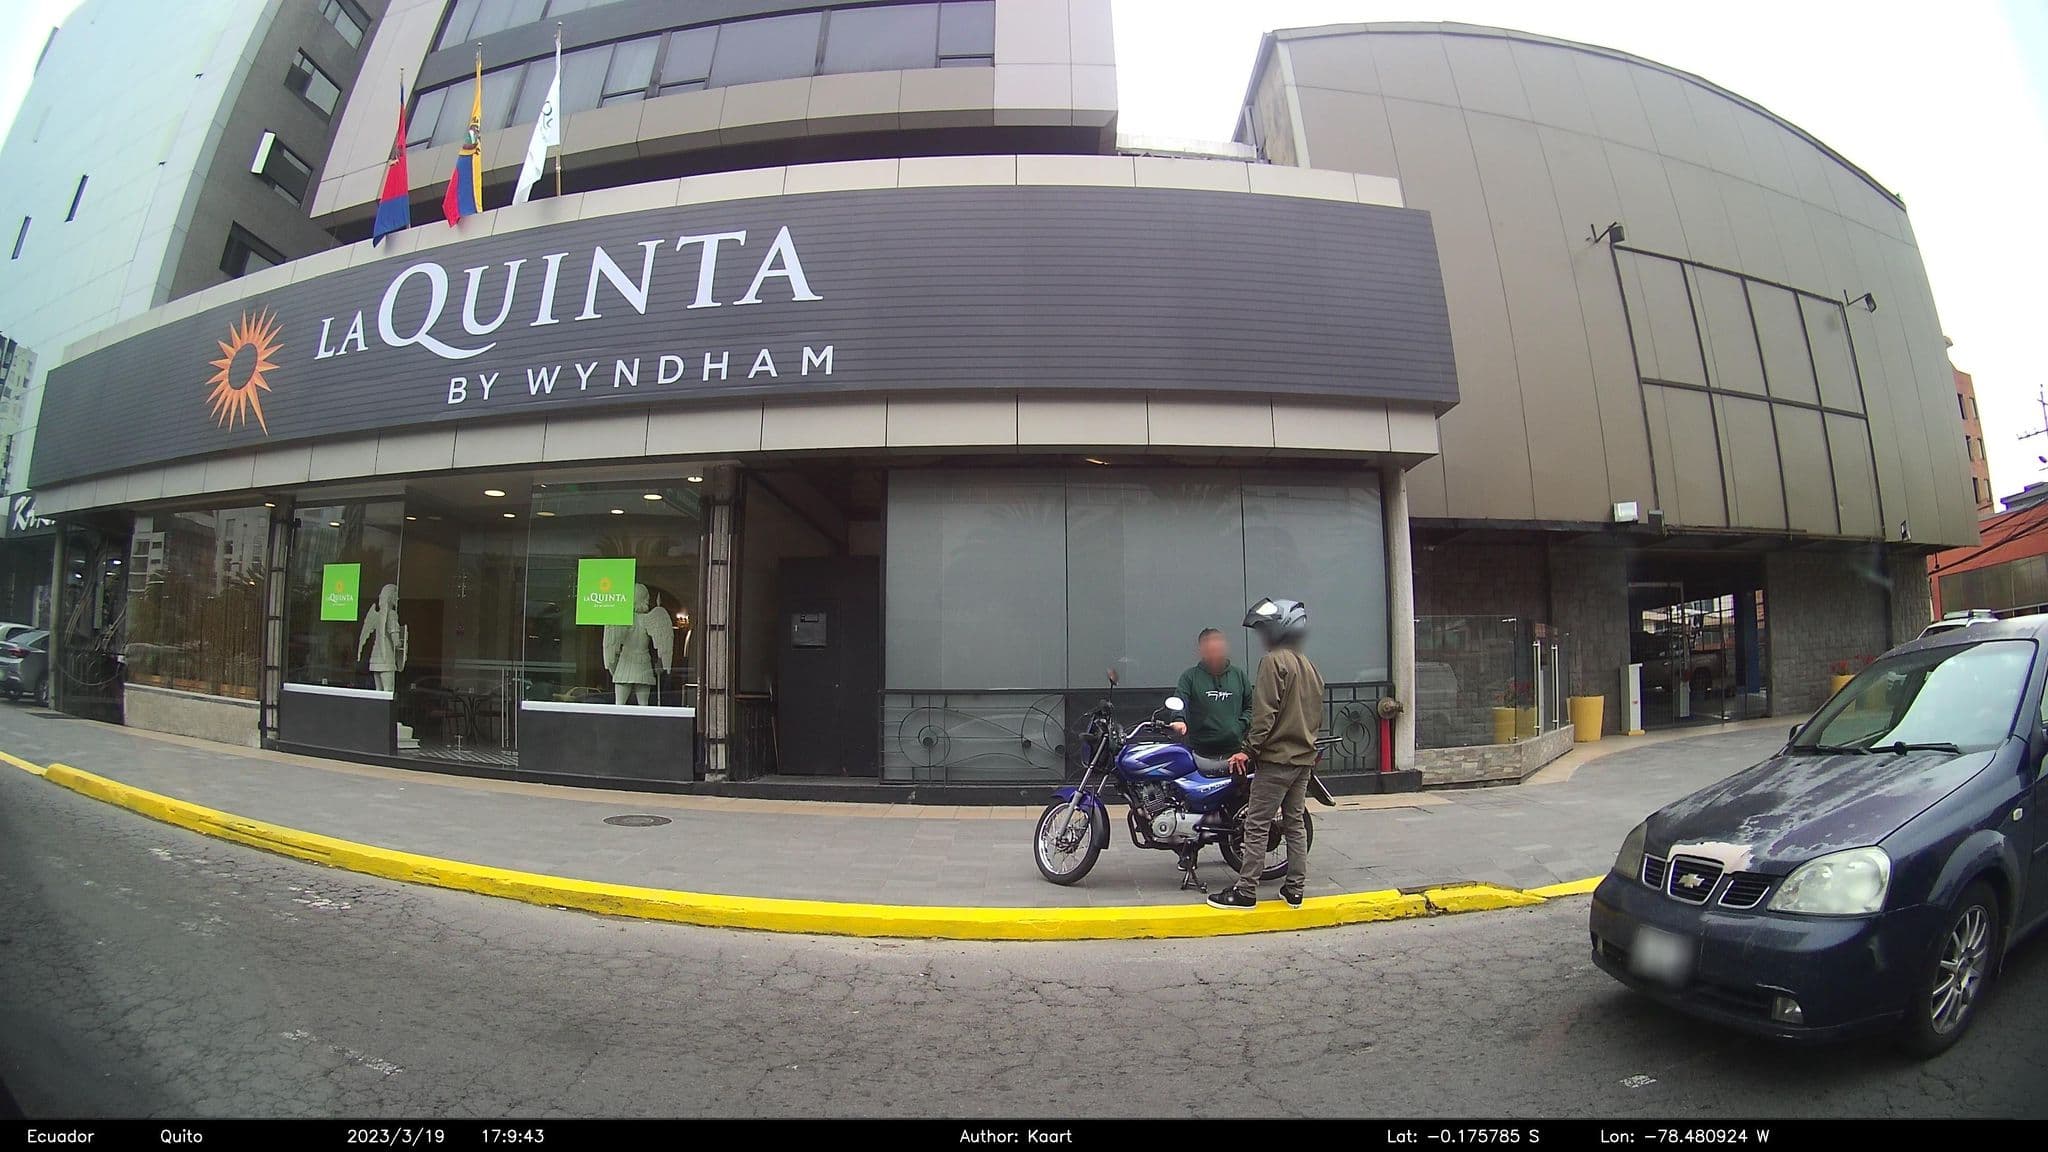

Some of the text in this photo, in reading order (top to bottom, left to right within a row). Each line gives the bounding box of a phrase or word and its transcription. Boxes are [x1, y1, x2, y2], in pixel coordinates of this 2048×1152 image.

[314, 225, 824, 361] LA QUINTA
[447, 345, 834, 405] BY WYNDHAM
[590, 592, 626, 604] QUINTA
